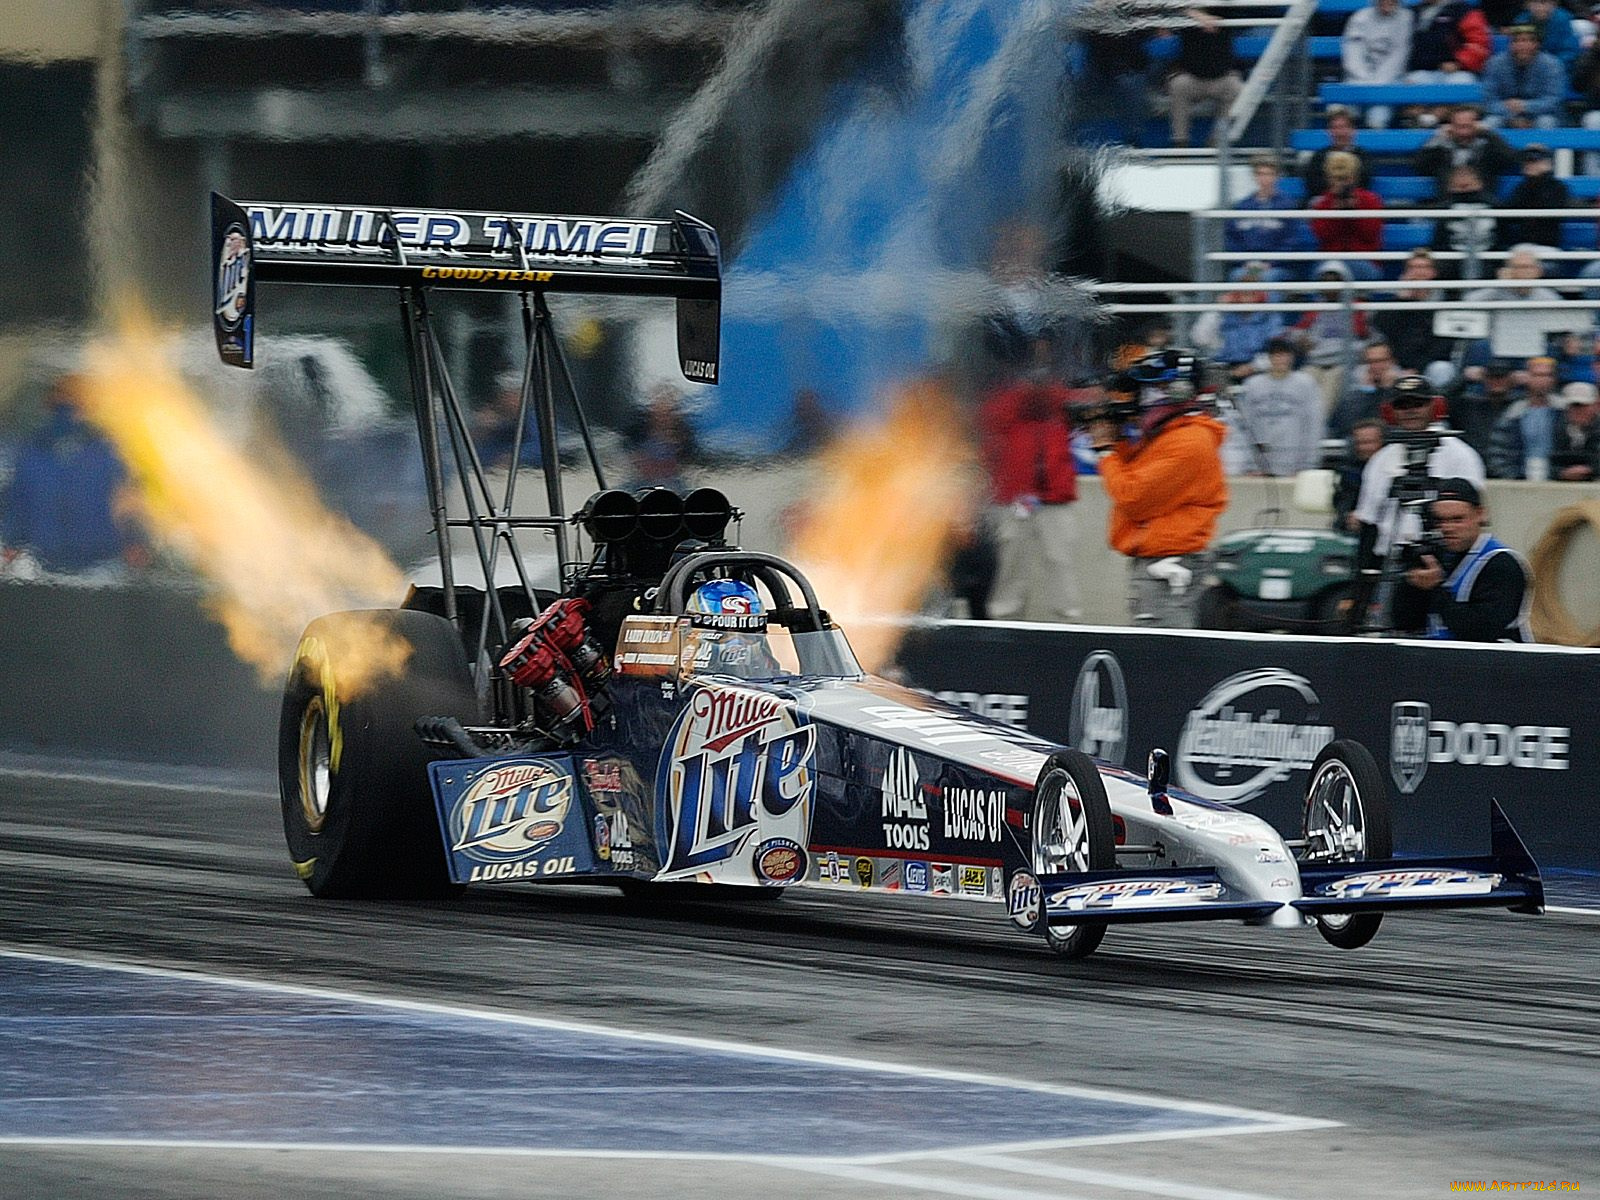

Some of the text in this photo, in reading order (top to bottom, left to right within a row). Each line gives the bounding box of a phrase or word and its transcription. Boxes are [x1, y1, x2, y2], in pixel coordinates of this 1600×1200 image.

[247, 207, 470, 256] MILLER
[422, 265, 554, 282] GOODYEAR
[712, 615, 738, 628] POUR
[739, 617, 748, 628] IT
[693, 688, 782, 740] Miller
[1428, 720, 1571, 770] DODGE
[452, 775, 573, 851] Lite
[652, 724, 816, 881] Lite
[944, 787, 986, 841] LUCAS
[883, 822, 931, 850] TOOLS
[469, 856, 577, 882] LUCAS OIL
